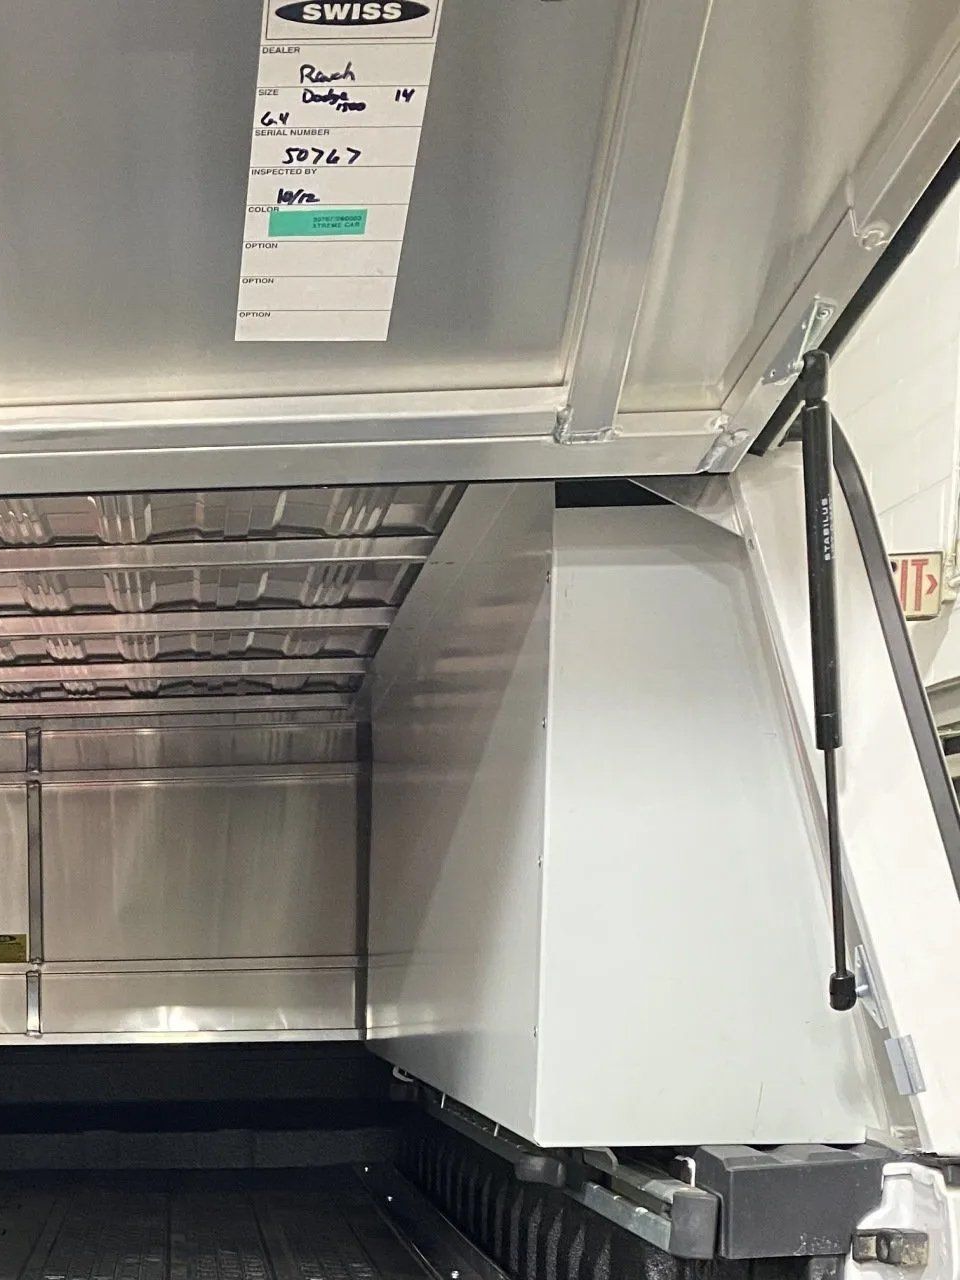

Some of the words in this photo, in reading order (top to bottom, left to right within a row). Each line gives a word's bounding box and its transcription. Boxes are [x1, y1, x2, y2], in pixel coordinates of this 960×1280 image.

[302, 2, 403, 21] SWISS
[262, 46, 301, 54] DEALER
[258, 88, 279, 96] SIZE
[394, 89, 415, 103] 14
[282, 147, 362, 164] 50767
[304, 168, 317, 176] BY
[821, 498, 831, 561] STABILUS
[900, 559, 929, 611] IT
